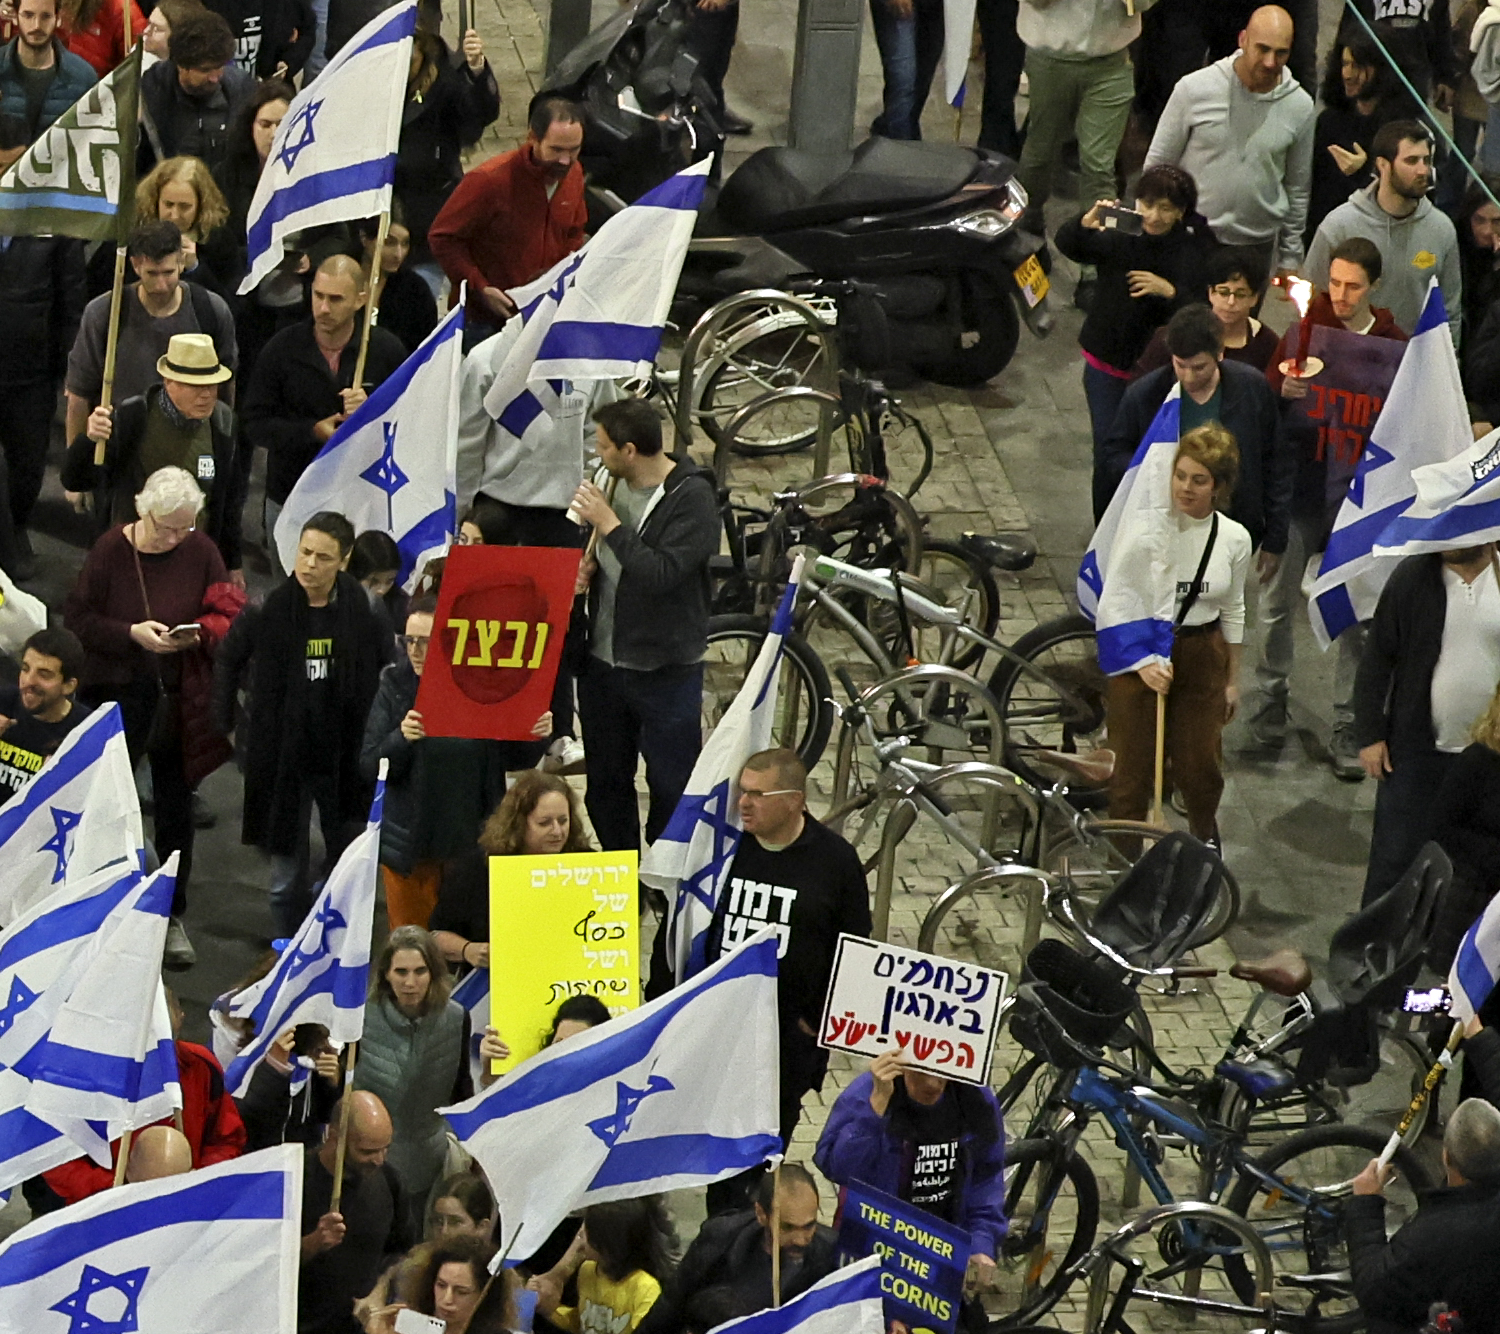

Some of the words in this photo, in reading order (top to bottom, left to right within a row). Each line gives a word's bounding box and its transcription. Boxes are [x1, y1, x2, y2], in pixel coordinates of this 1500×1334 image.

[447, 618, 550, 669] נבצר
[530, 864, 629, 889] ירושלים
[592, 890, 629, 913] של
[729, 877, 798, 924] דמו
[581, 945, 629, 971] ושל
[858, 1201, 894, 1233] THE
[893, 1219, 955, 1261] POWER
[873, 1240, 896, 1264] OF
[897, 1250, 932, 1280] THE
